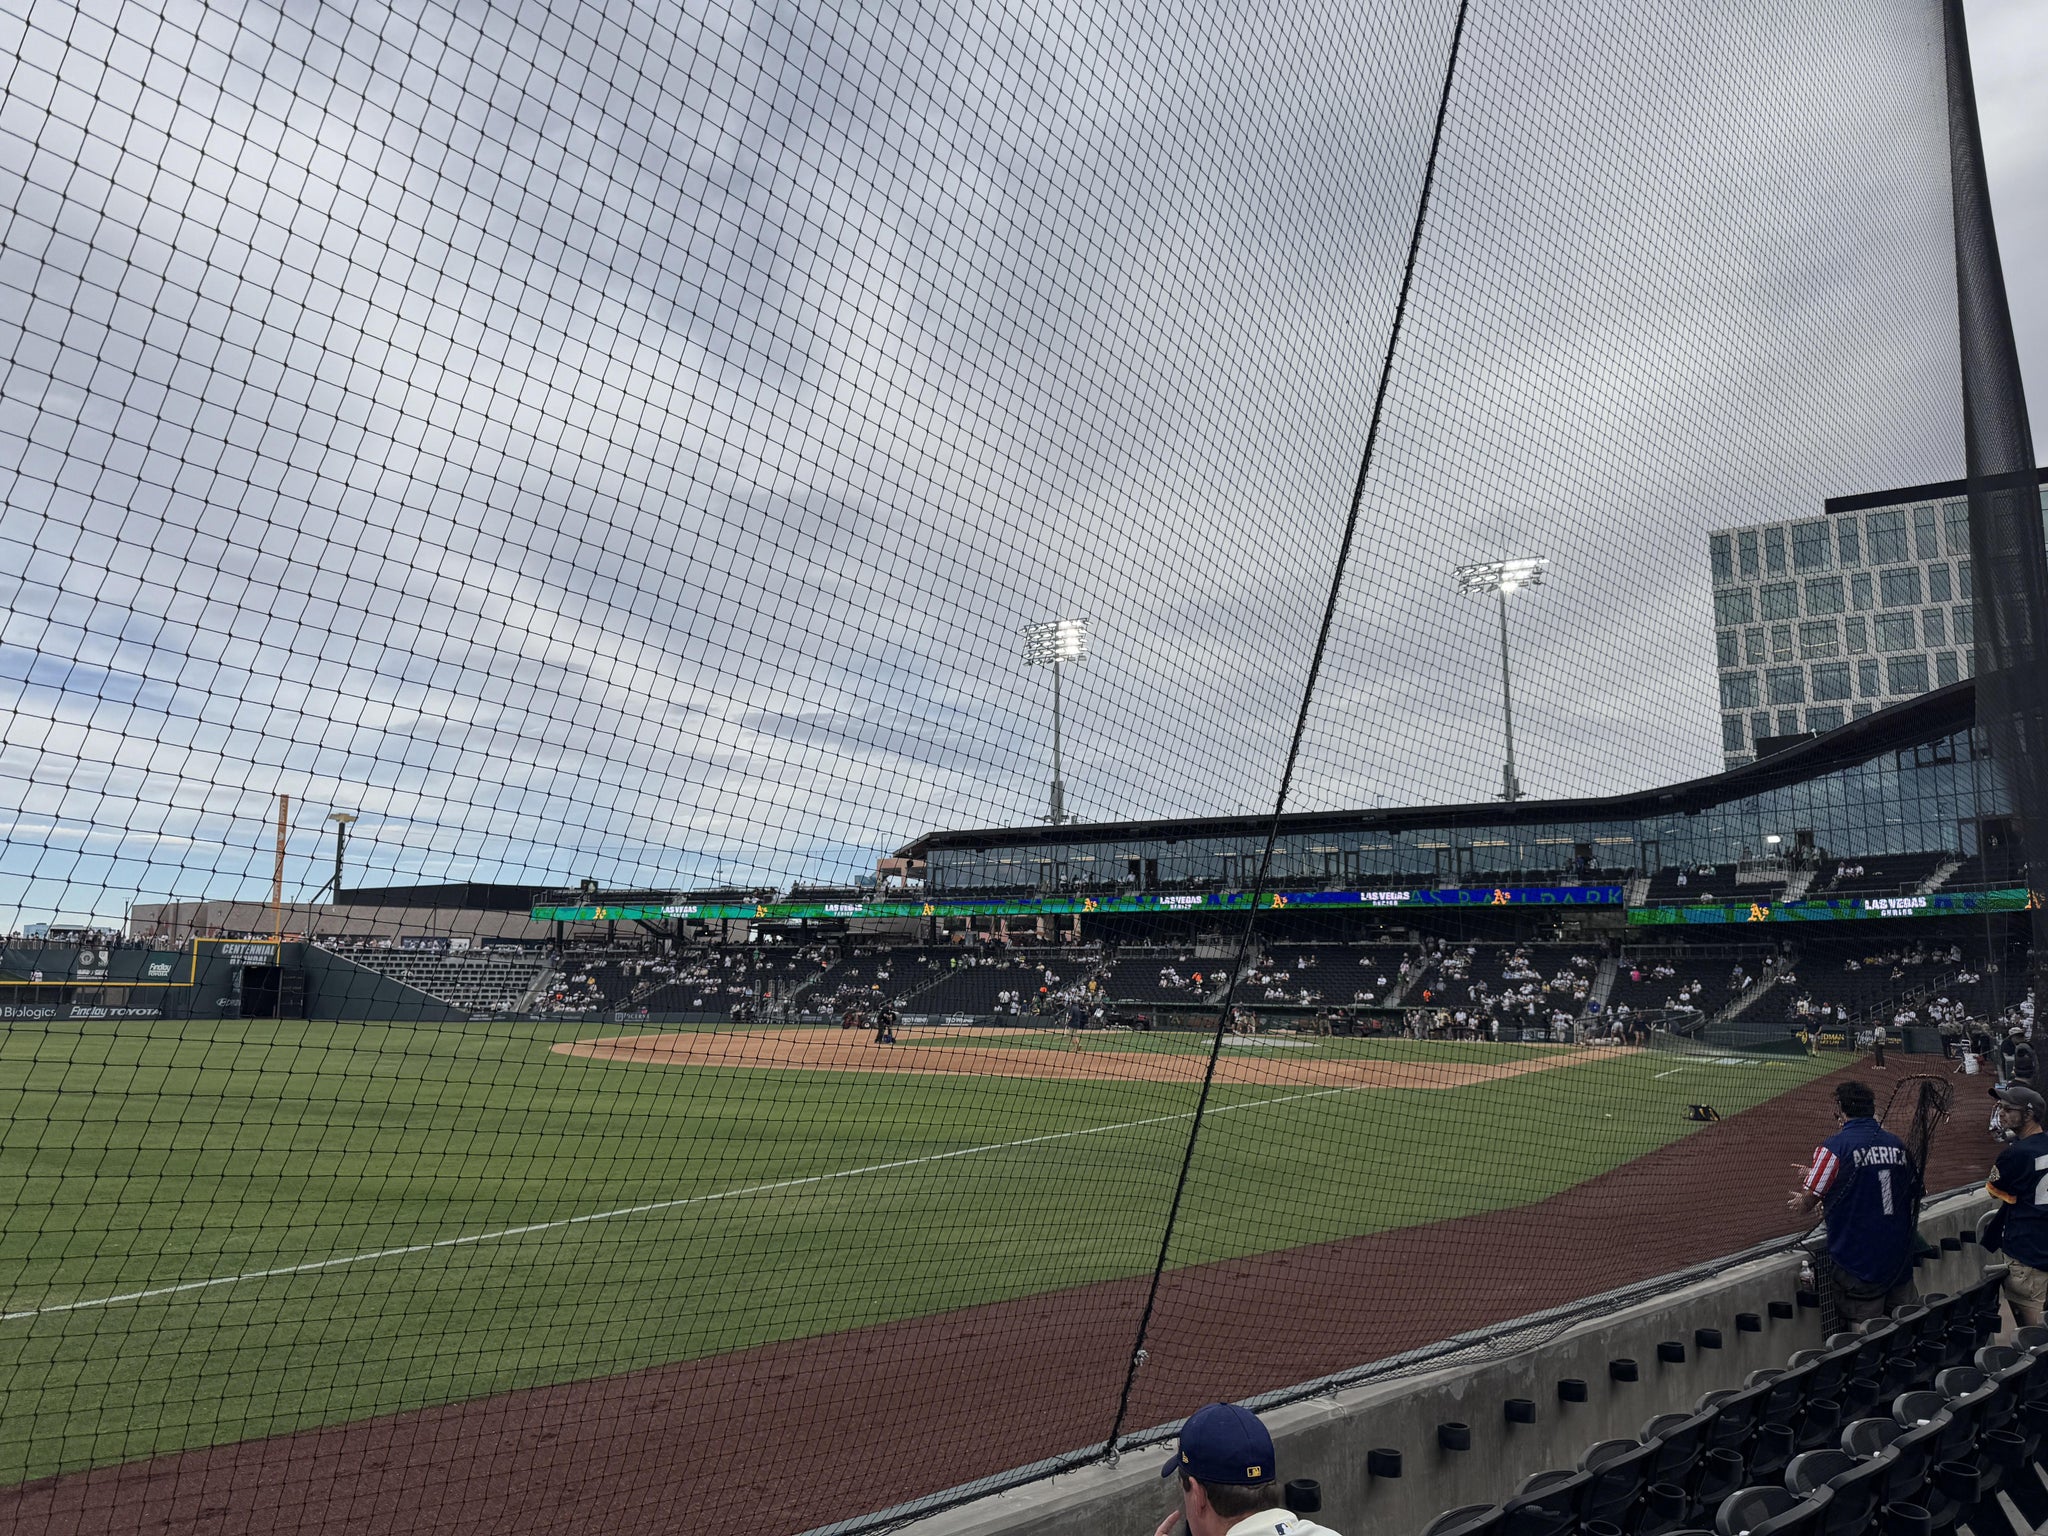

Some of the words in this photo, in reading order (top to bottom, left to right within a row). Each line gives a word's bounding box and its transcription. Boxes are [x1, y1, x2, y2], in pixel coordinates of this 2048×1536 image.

[1361, 892, 1378, 901] LAS
[1379, 891, 1410, 900] VEGAS
[1865, 899, 1887, 910] LAS
[1888, 897, 1926, 909] VEGAS
[222, 944, 275, 955] CENTENNIAL
[4, 1006, 56, 1019] Biologics
[109, 1008, 162, 1016] TOYOTA
[1853, 1146, 1907, 1168] AMERICA
[1878, 1169, 1894, 1216] 1
